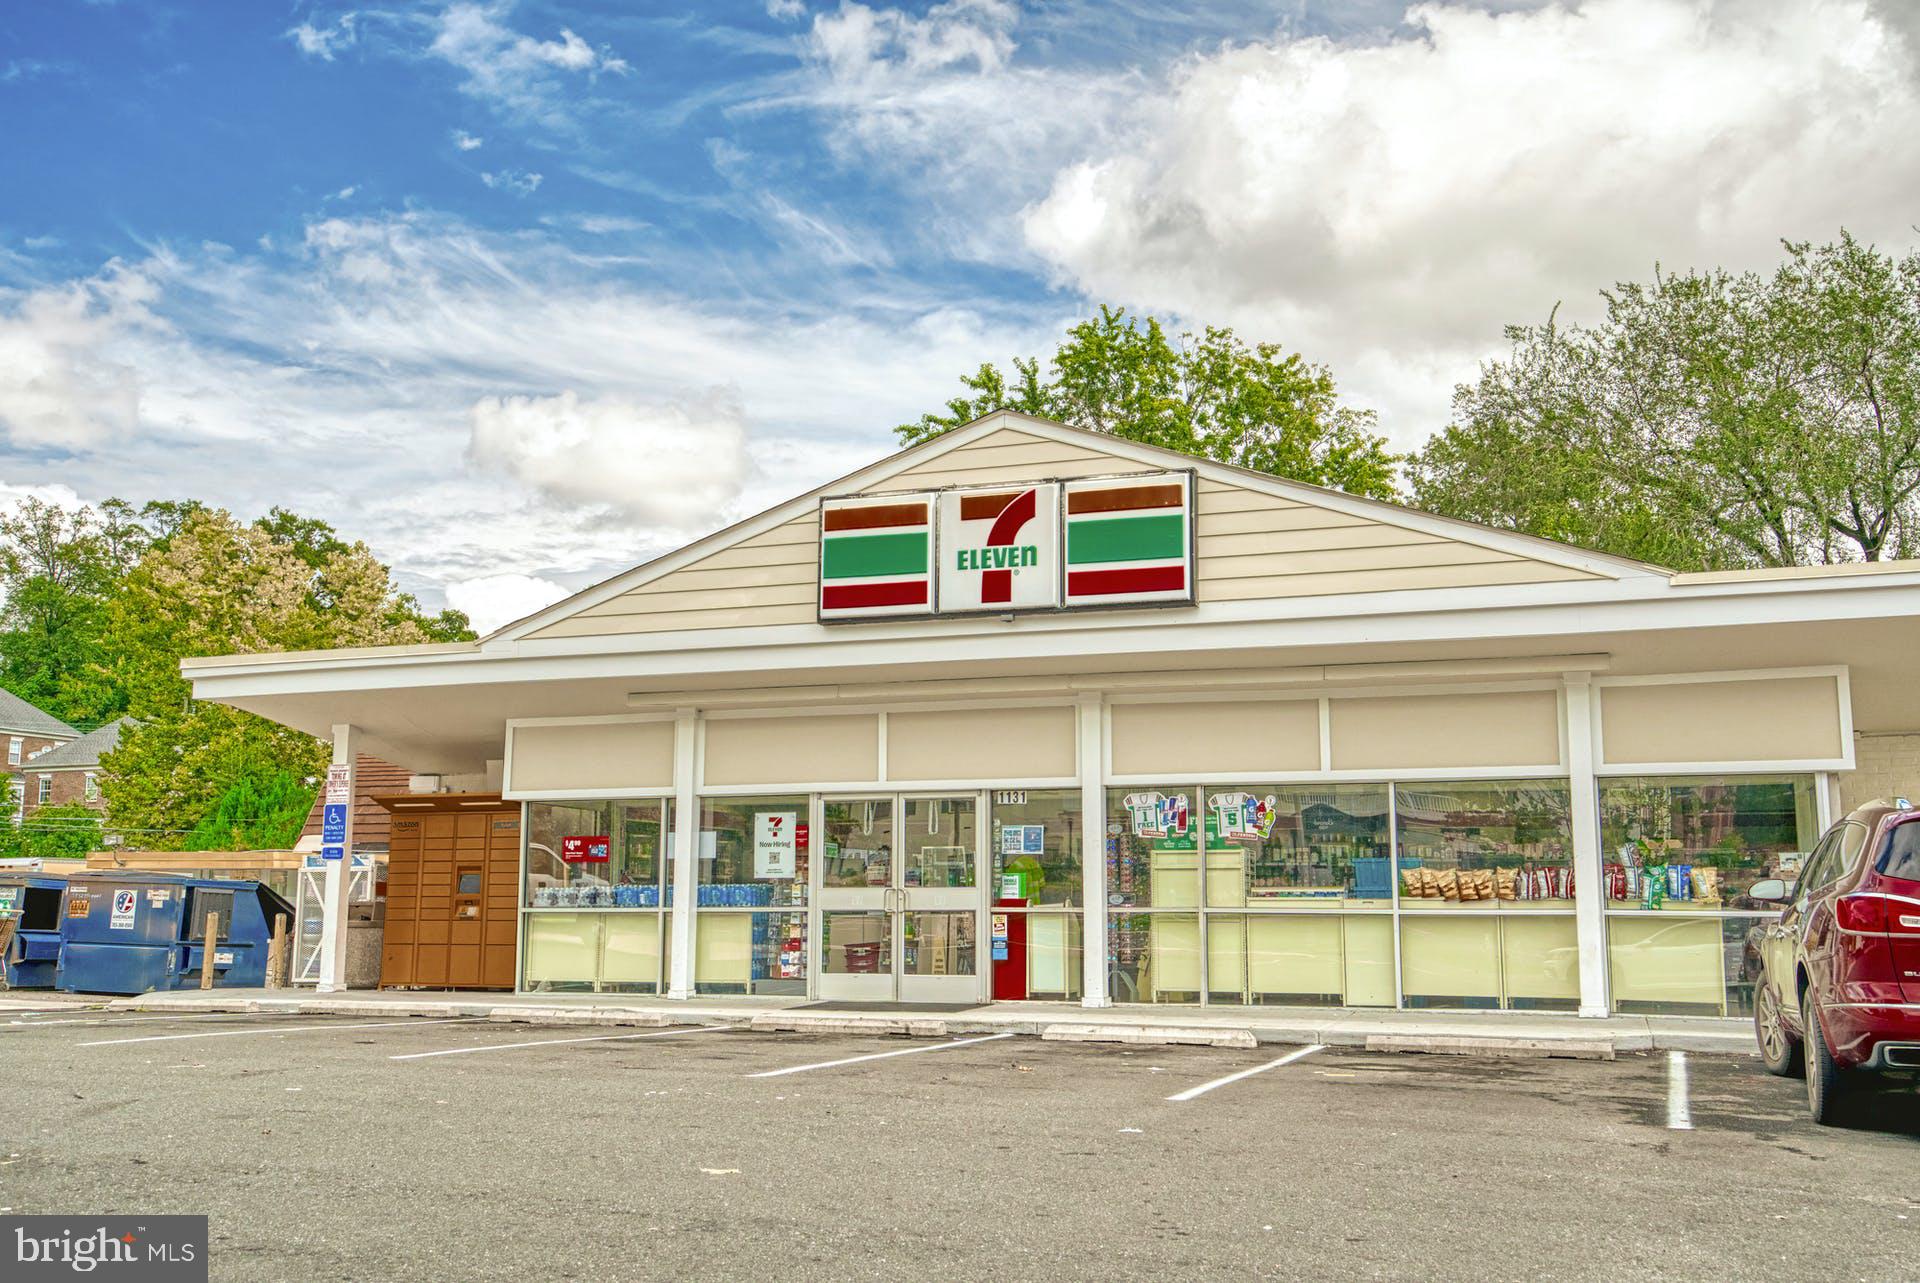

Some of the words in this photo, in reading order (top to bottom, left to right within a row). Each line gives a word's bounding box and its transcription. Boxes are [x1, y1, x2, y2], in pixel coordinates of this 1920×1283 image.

[960, 489, 1036, 604] 7
[999, 791, 1026, 803] 1131
[773, 840, 791, 848] Hiring
